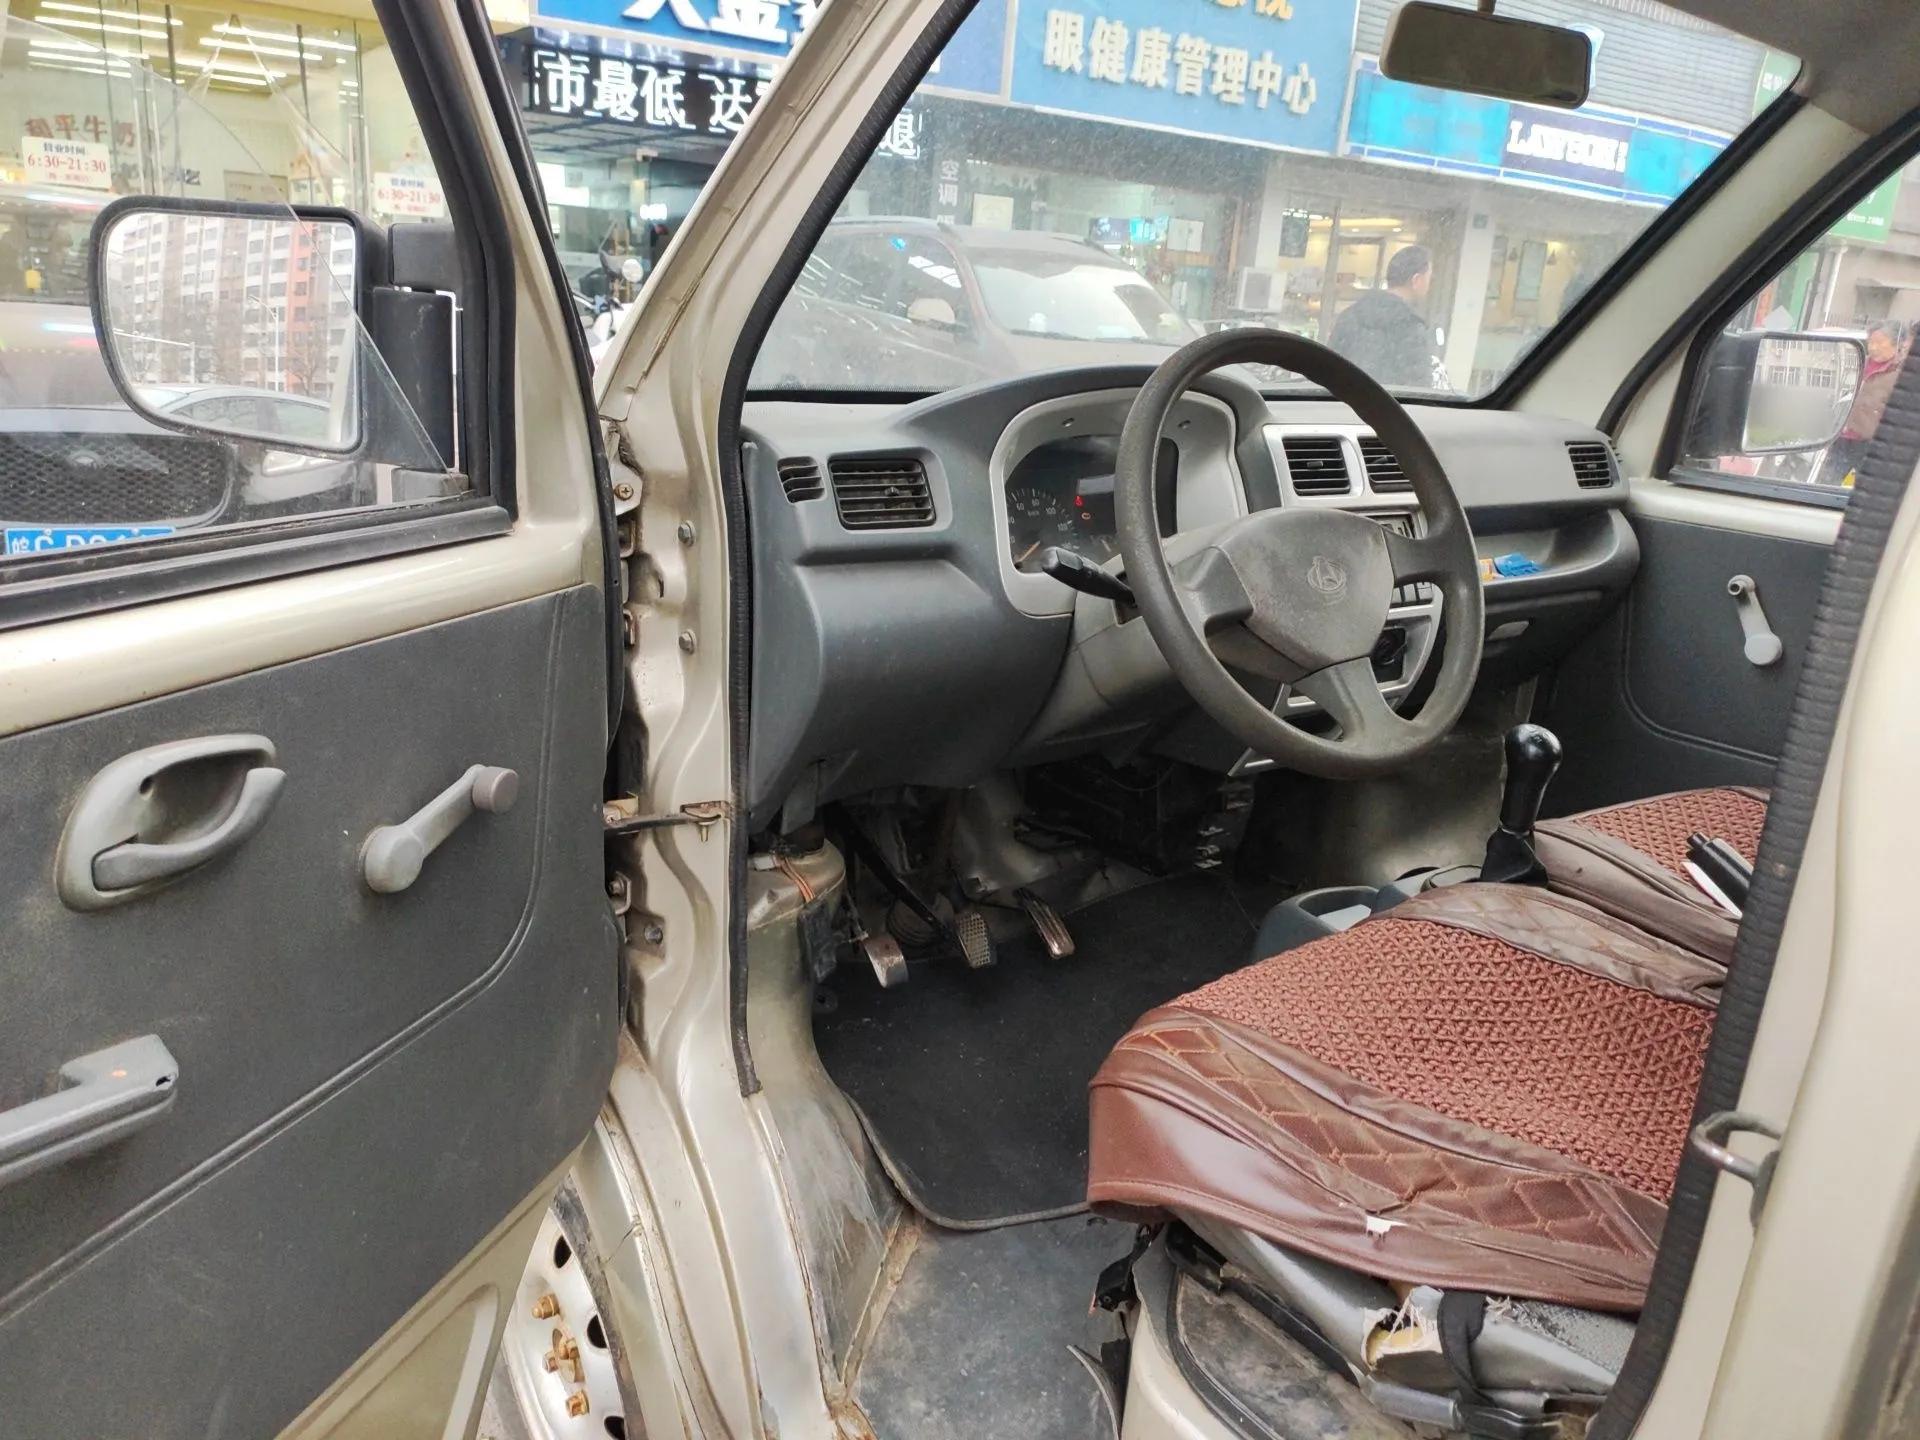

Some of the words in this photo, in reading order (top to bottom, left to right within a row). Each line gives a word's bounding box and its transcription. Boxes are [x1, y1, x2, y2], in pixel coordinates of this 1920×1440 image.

[542, 54, 688, 128] 市最低
[1043, 9, 1318, 115] 眼健康管理中心
